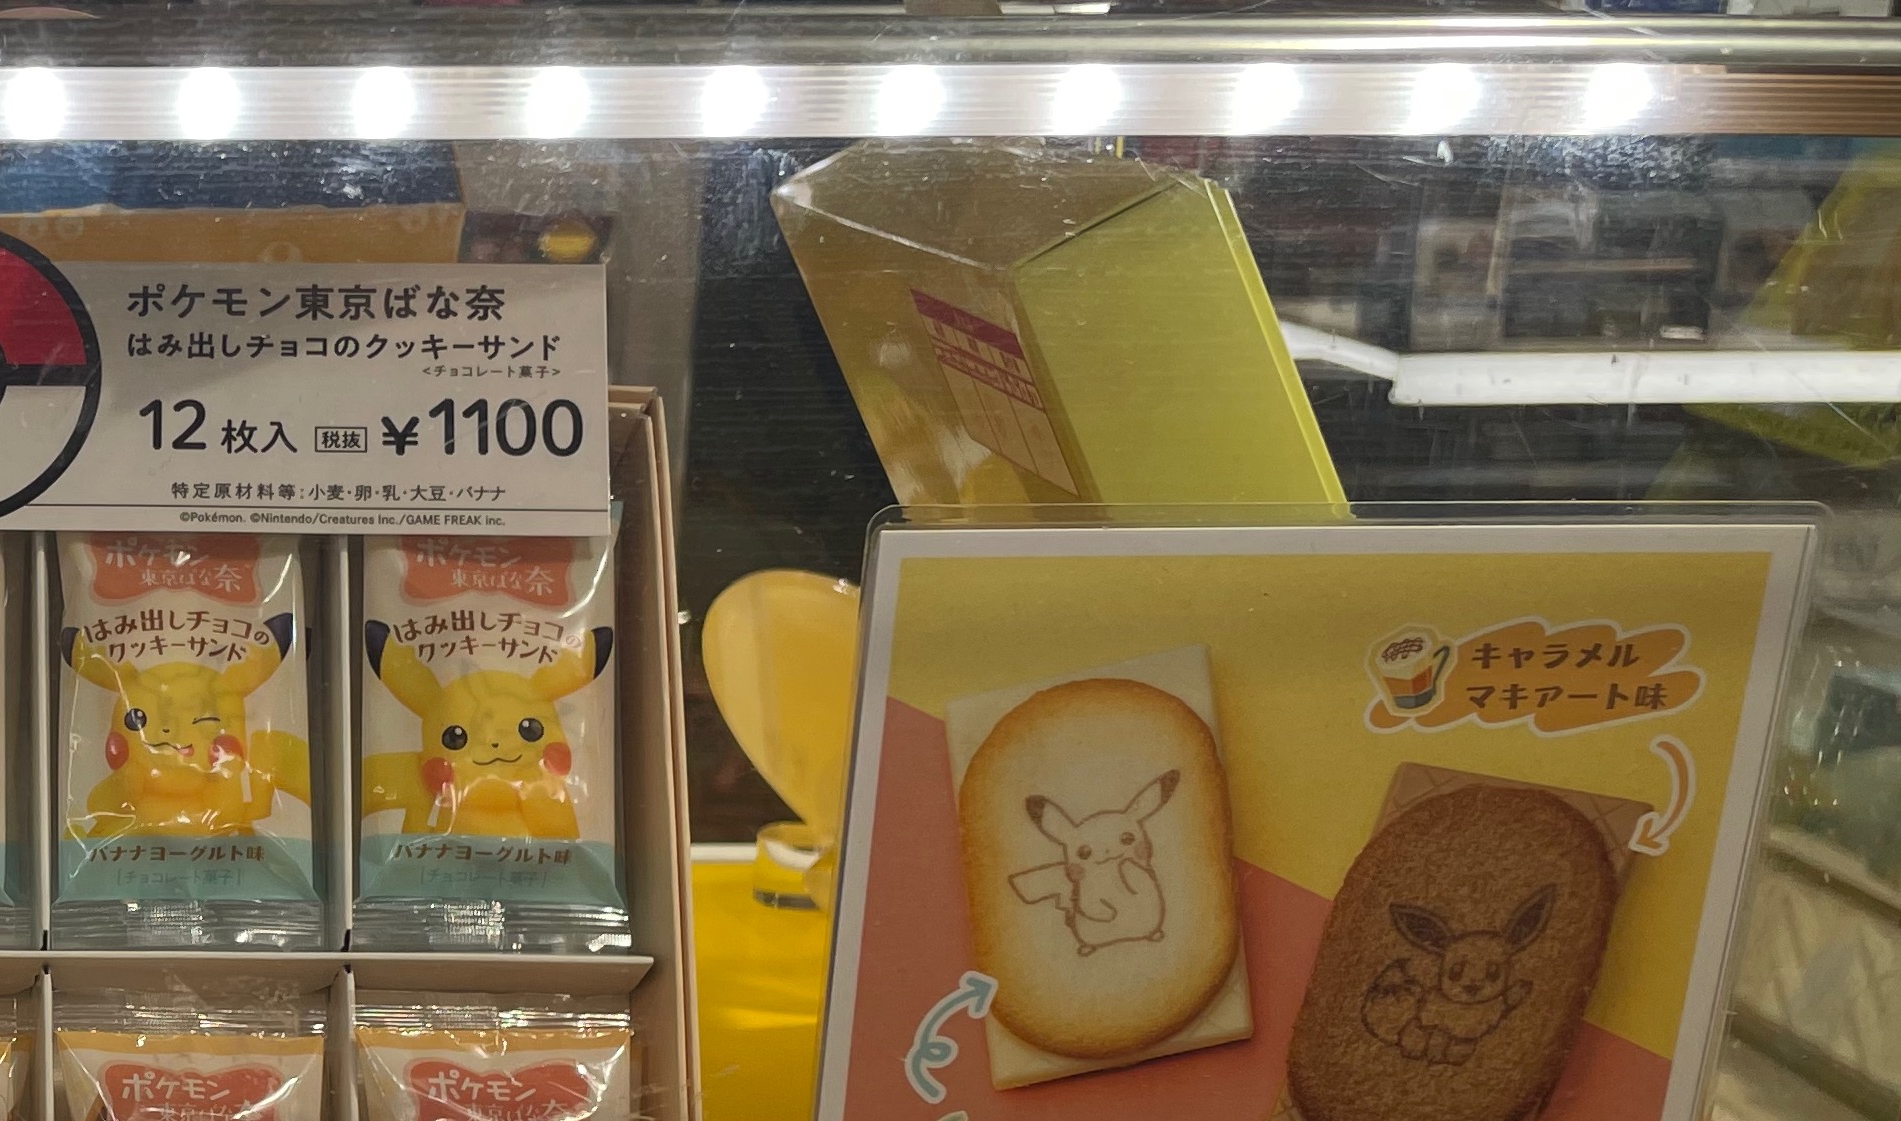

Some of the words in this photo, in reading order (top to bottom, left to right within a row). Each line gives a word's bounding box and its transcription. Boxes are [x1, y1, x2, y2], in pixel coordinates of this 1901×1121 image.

[127, 283, 506, 322] ポケモン東京ばな奈
[128, 333, 561, 360] はみ出しチョコのクッキーサンド
[321, 429, 362, 451] 税抜
[381, 396, 584, 458] ¥1100
[444, 514, 482, 526] FREAK
[85, 609, 270, 645] はみ出しチョコの
[393, 611, 582, 651] はみ出しチョコの
[108, 636, 247, 664] クッキーサンド
[418, 637, 559, 665] クッキーサンド
[1471, 643, 1639, 669] キャラメル
[1465, 684, 1669, 710] マキアート味
[90, 845, 265, 862] バナナヨーグルト味
[395, 844, 573, 865] バナナヨーグルト味
[122, 1070, 230, 1101] ポケモン
[428, 1070, 536, 1101] ポケモン
